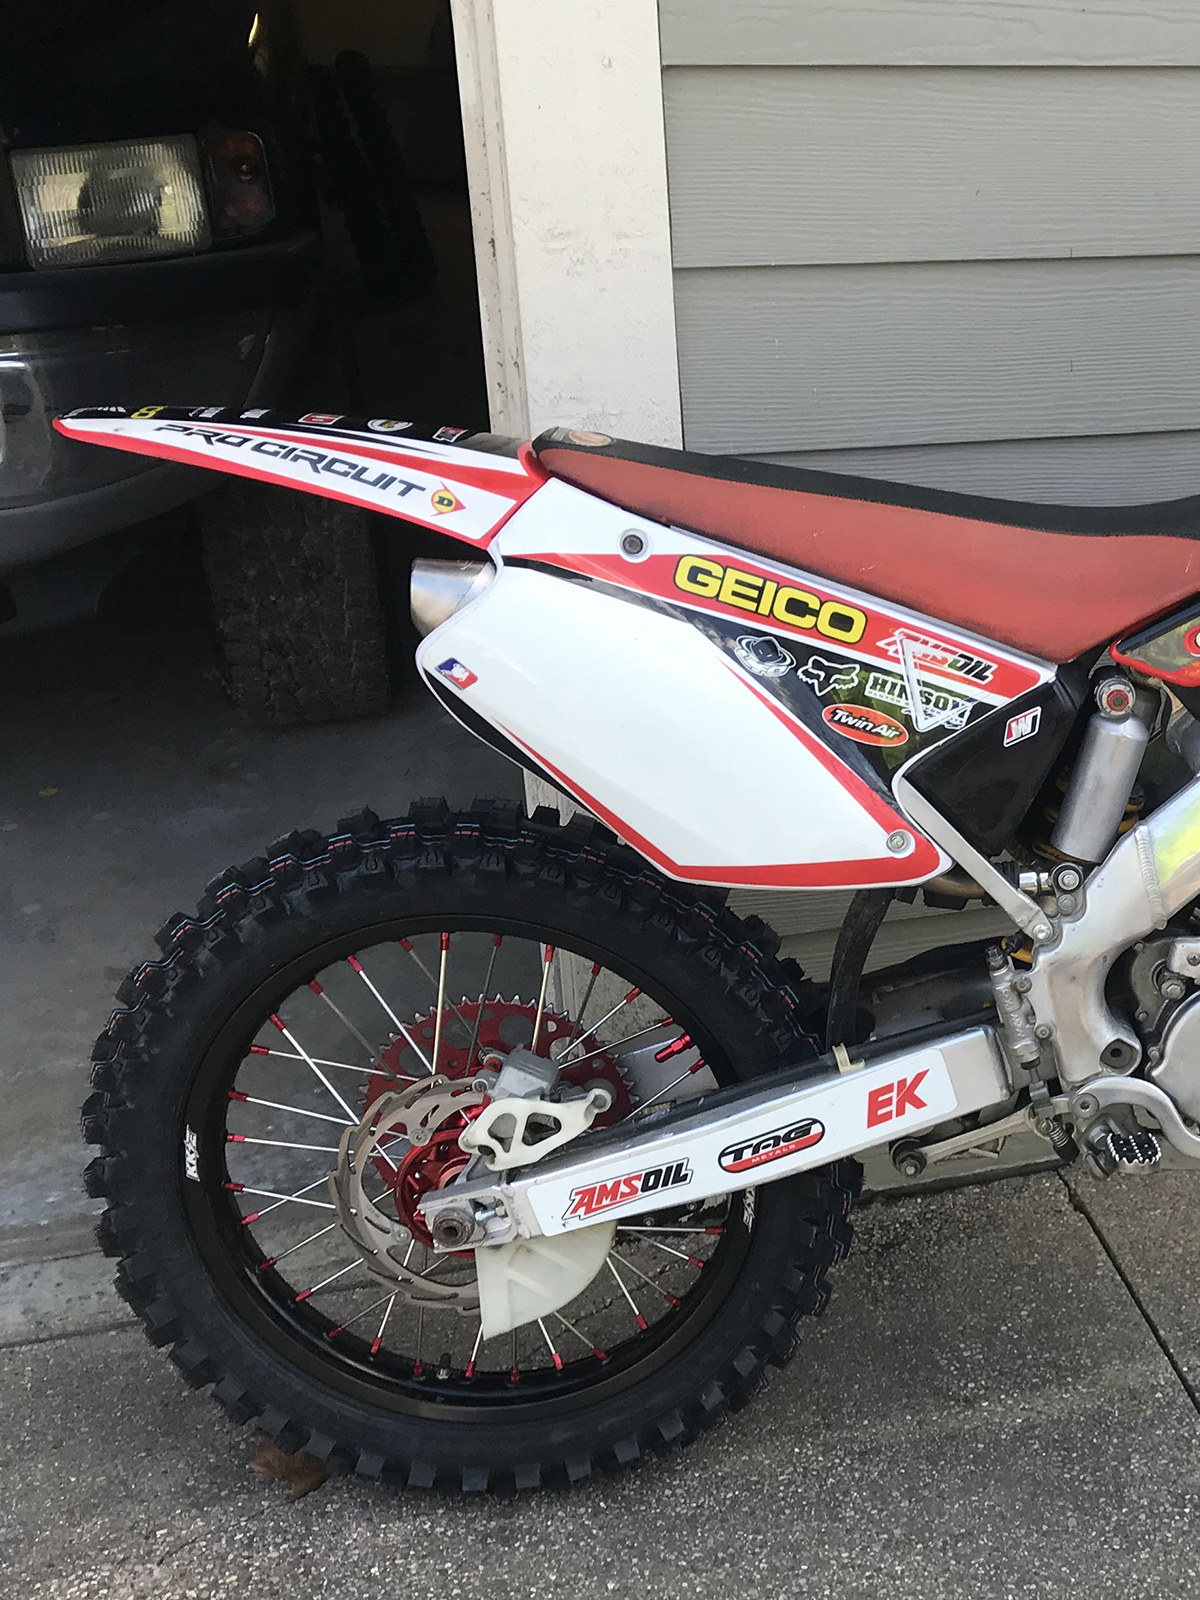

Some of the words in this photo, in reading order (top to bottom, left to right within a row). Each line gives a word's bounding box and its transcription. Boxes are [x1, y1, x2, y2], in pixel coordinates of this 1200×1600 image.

[152, 423, 252, 447] PRO
[250, 440, 428, 499] CIRCUIT
[673, 554, 868, 643] GEICO
[831, 708, 875, 733] Twin
[872, 723, 902, 740] Air
[866, 1068, 930, 1129] EK
[722, 1120, 817, 1162] TAG
[751, 1144, 797, 1164] METALS
[568, 1161, 691, 1217] AMSOIL
